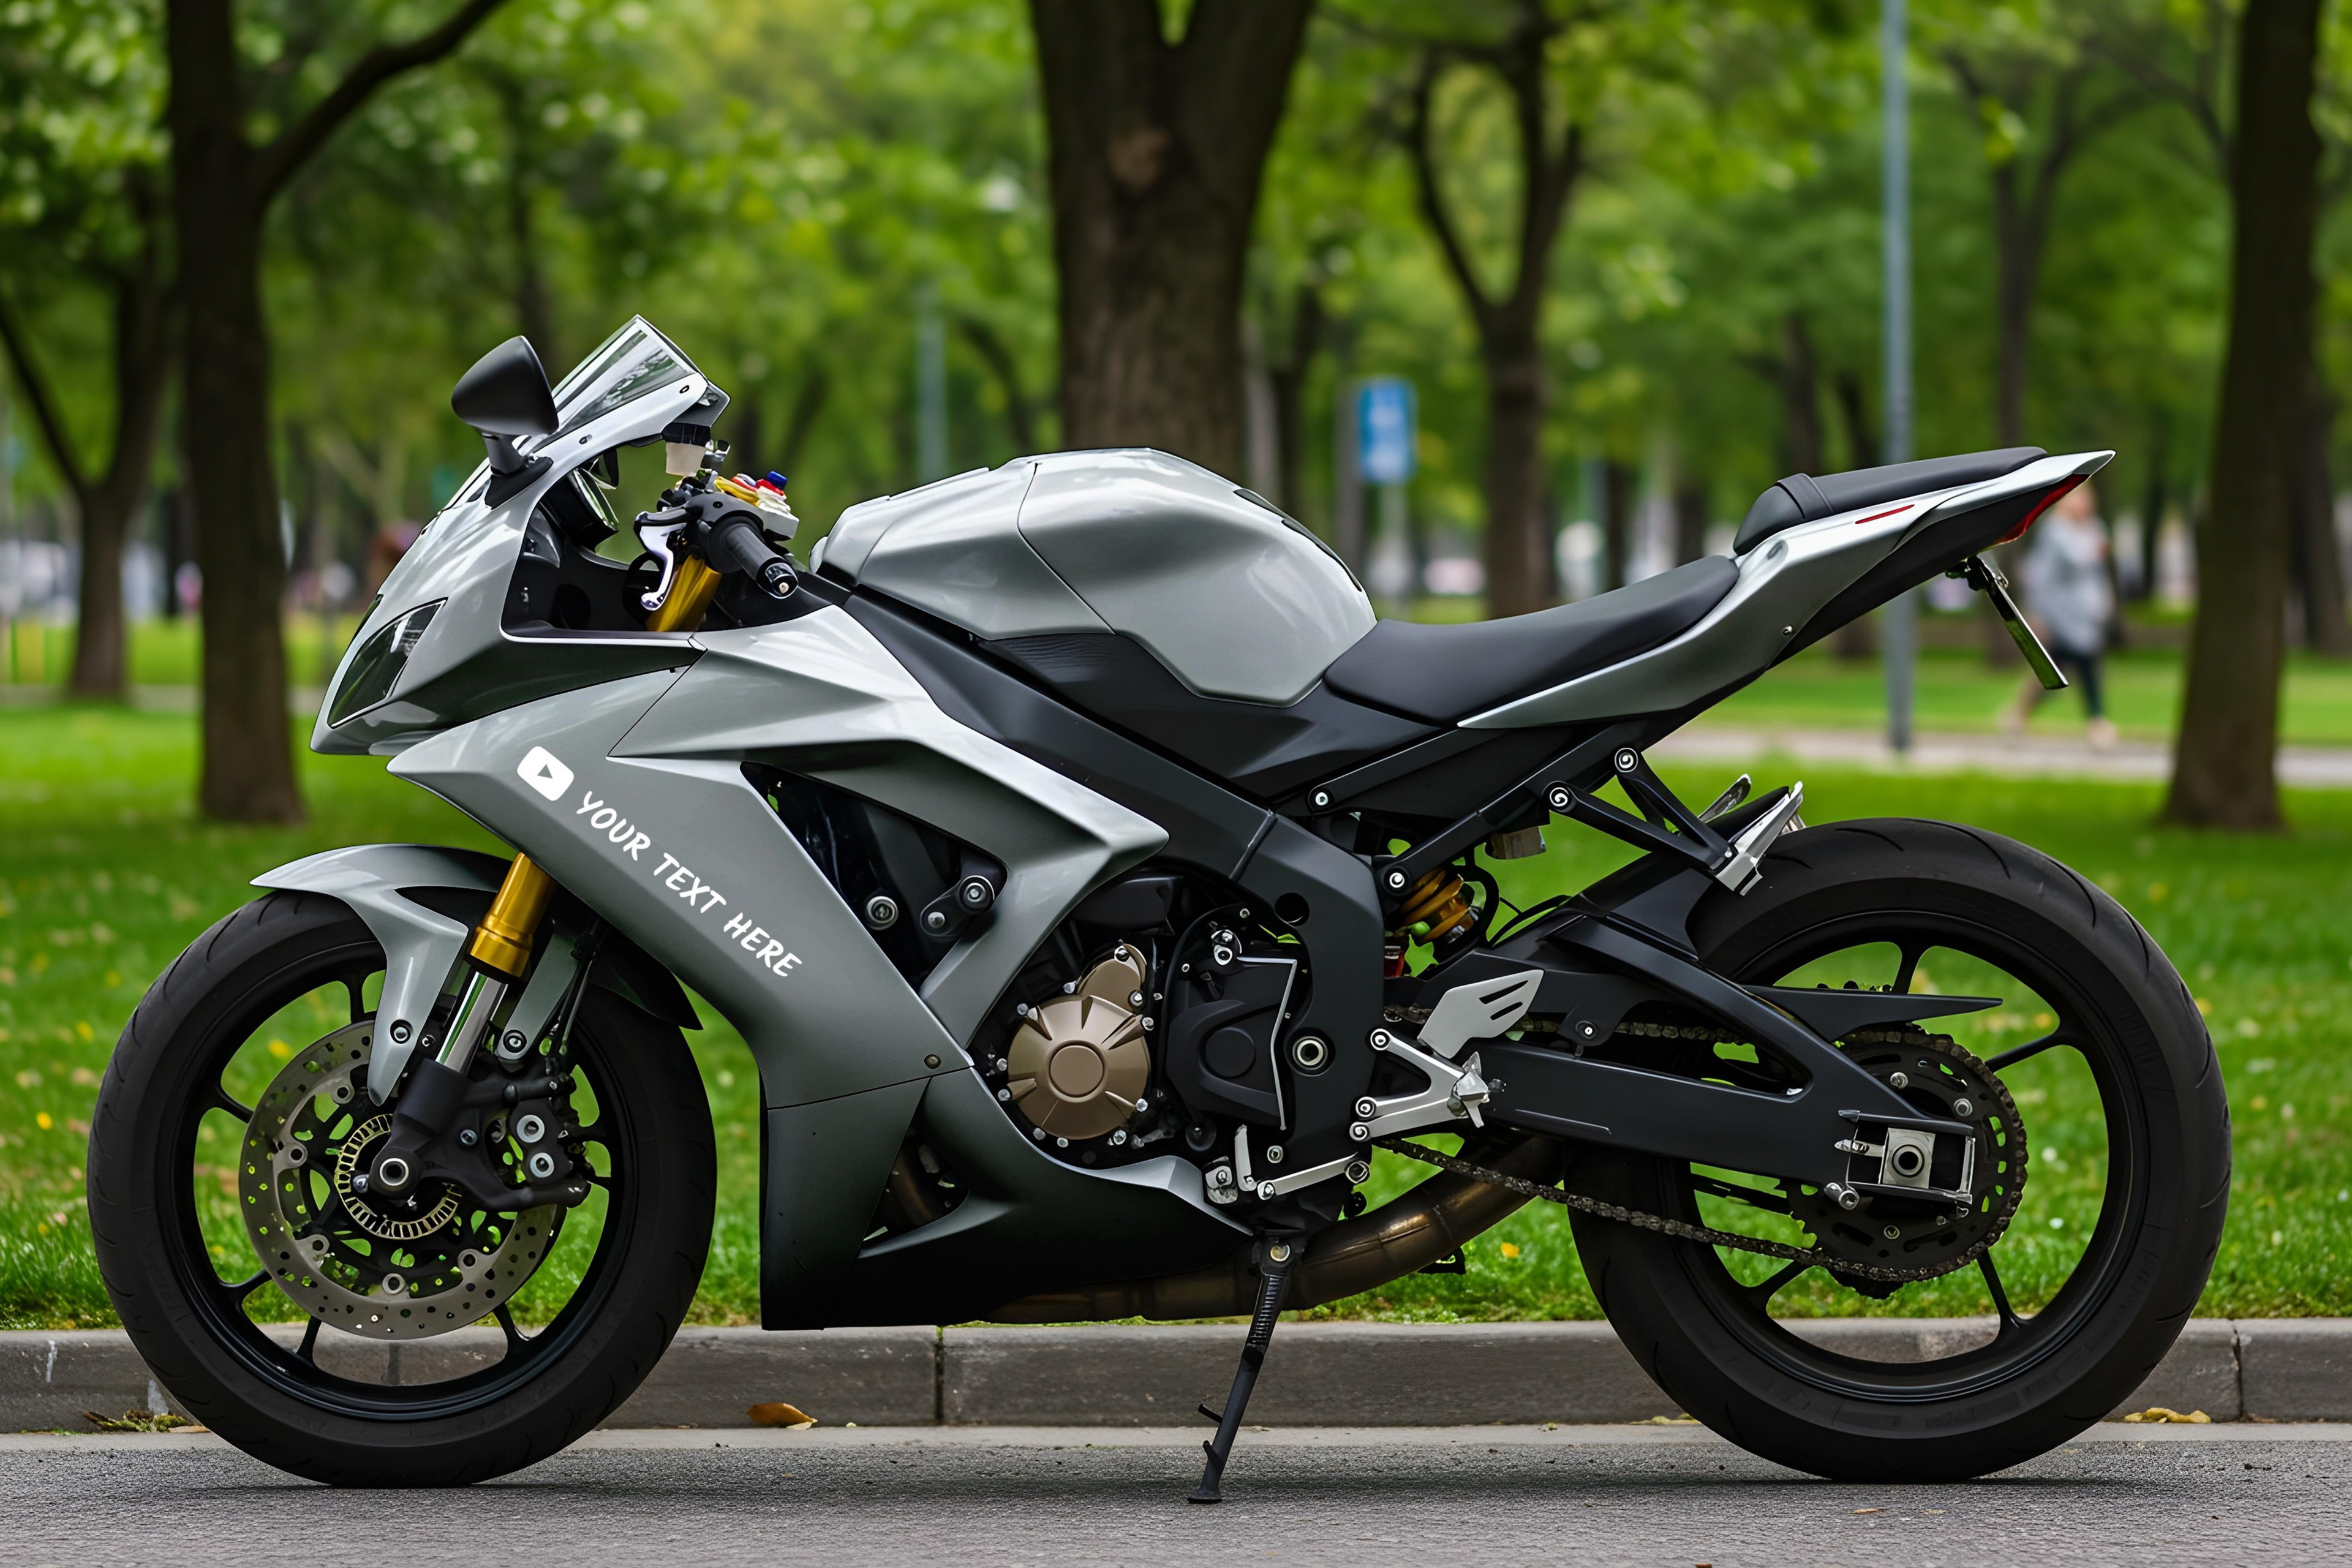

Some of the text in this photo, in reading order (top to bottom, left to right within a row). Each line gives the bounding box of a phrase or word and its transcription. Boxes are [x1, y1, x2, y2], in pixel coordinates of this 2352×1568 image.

[576, 791, 803, 977] YOUR TEXT HERE
